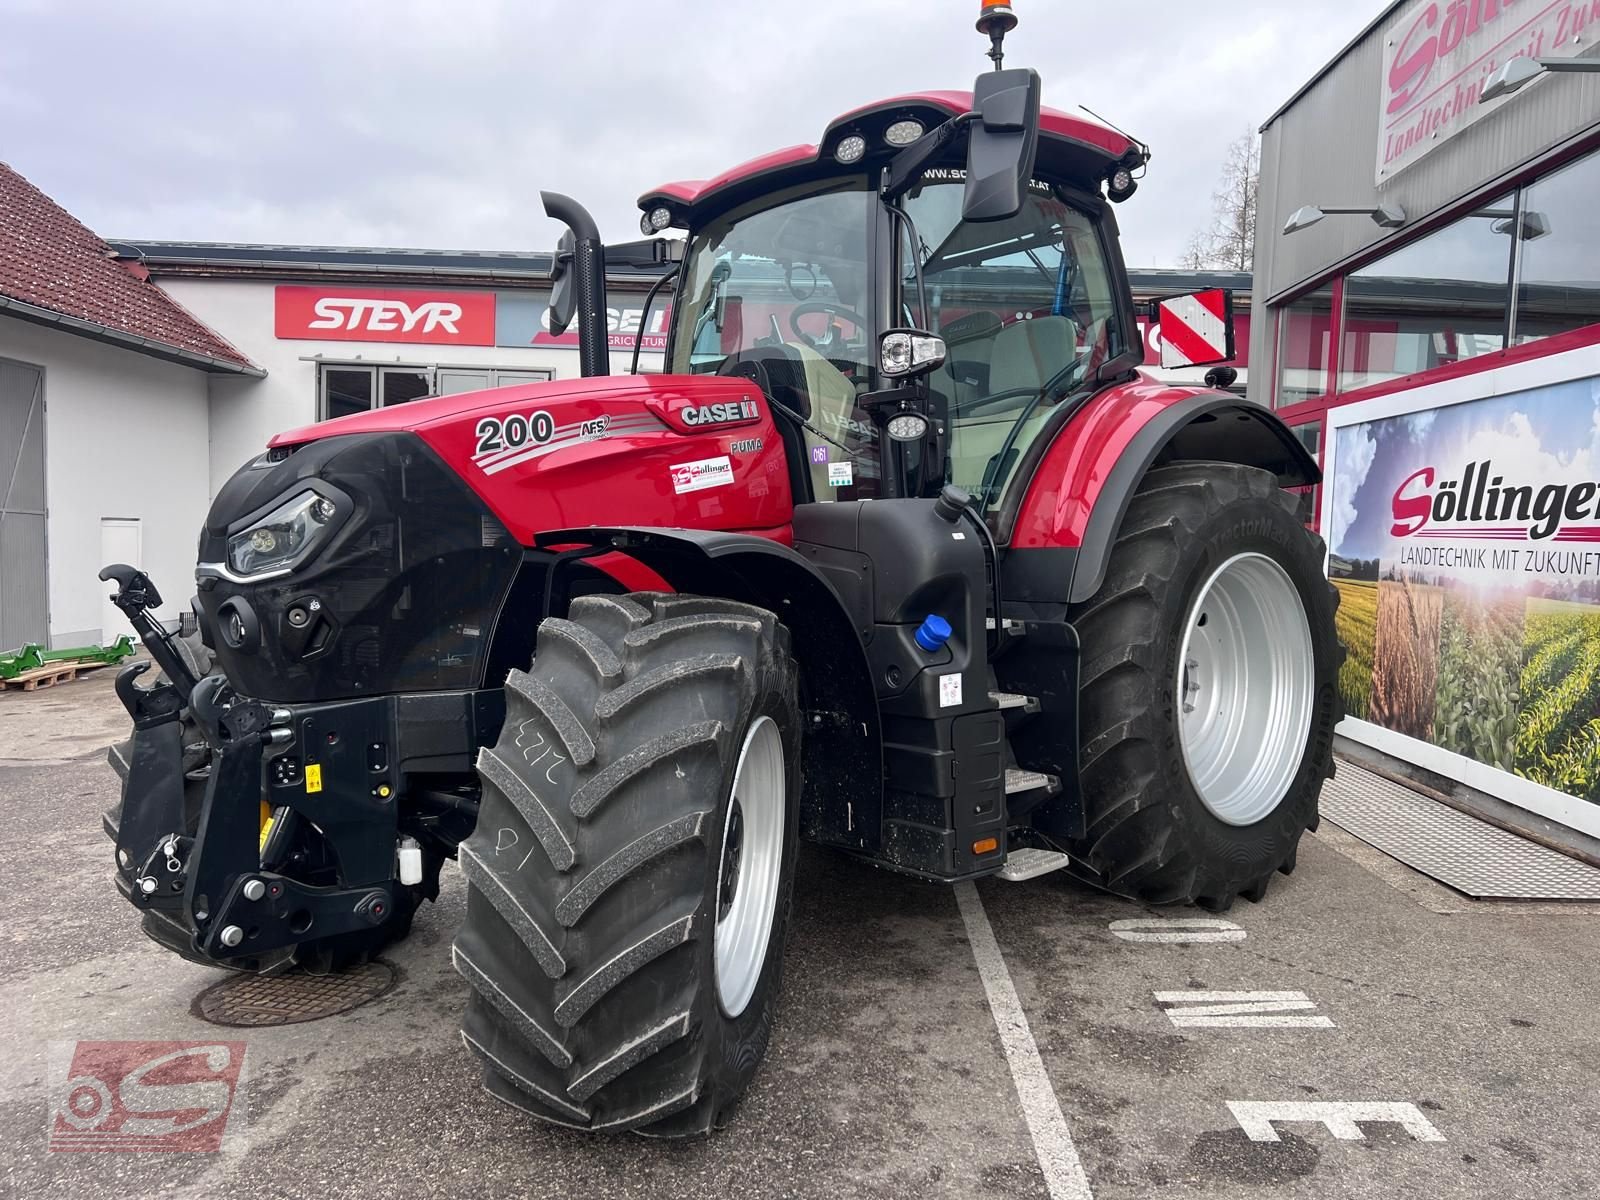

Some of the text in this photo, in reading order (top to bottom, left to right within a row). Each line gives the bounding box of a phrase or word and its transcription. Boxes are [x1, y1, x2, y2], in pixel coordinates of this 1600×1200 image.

[1508, 28, 1544, 58] it
[308, 297, 462, 334] STEYR
[581, 420, 605, 436] AFS
[681, 403, 740, 425] CASE
[475, 411, 555, 455] 200
[730, 438, 763, 454] PUMA
[1401, 546, 1600, 576] LANDTECHNIK MIT ZUKUNFT
